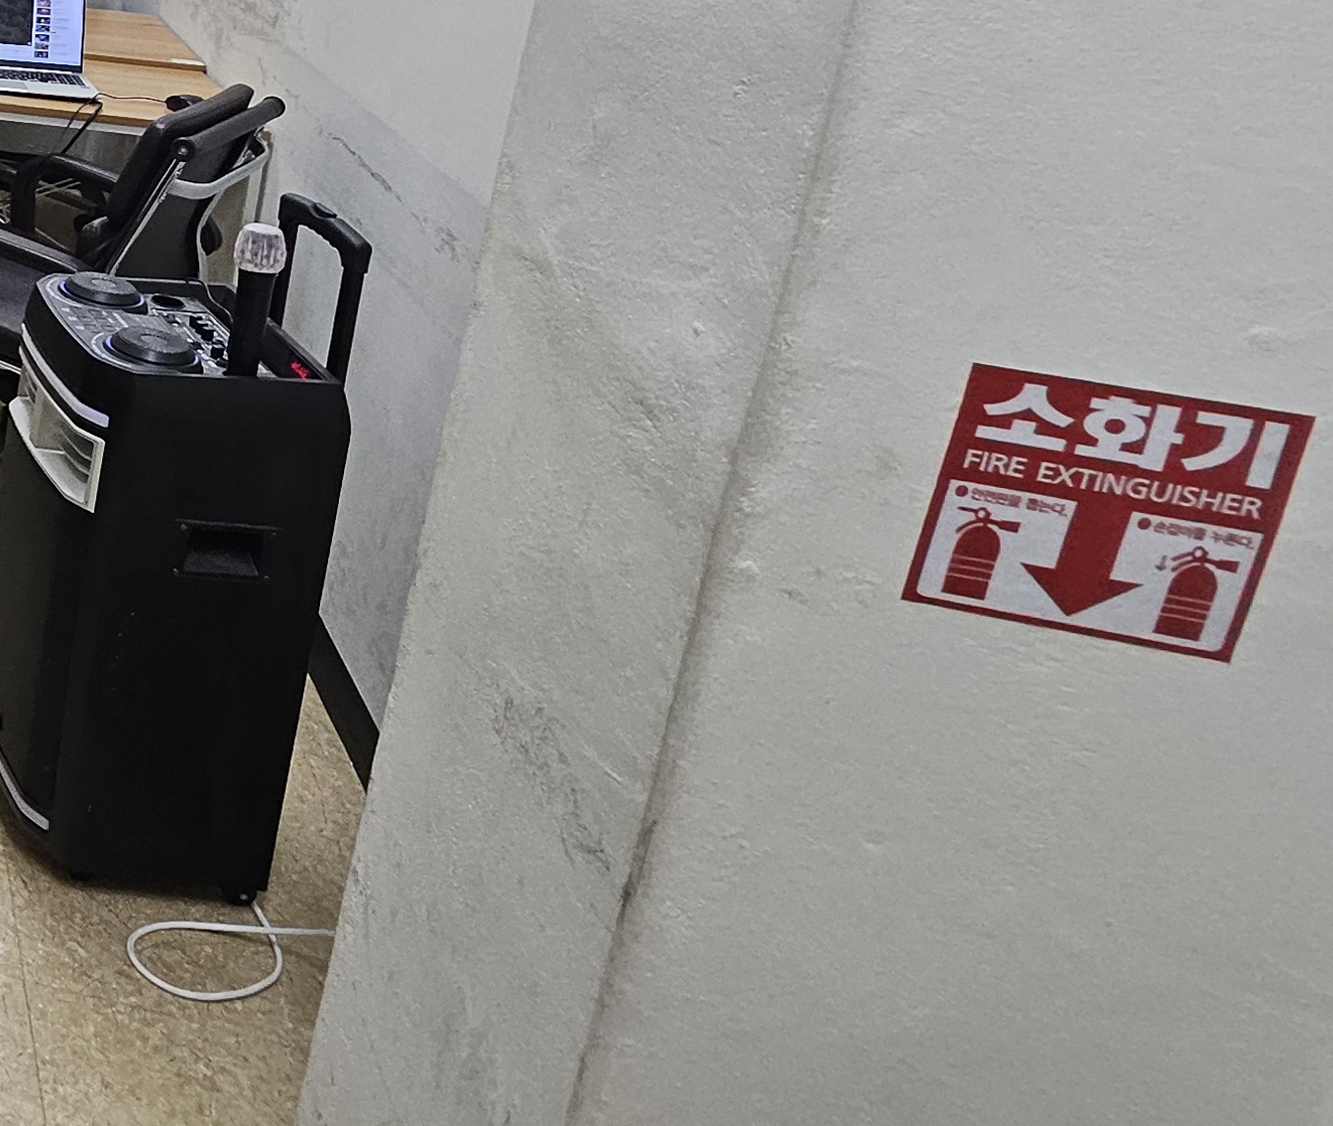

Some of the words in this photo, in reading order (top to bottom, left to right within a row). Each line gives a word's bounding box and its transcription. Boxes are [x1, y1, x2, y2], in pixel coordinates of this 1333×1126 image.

[974, 382, 1292, 490] 소화기
[962, 449, 1029, 480] FIRE
[1036, 463, 1263, 520] EXTINGUISHER
